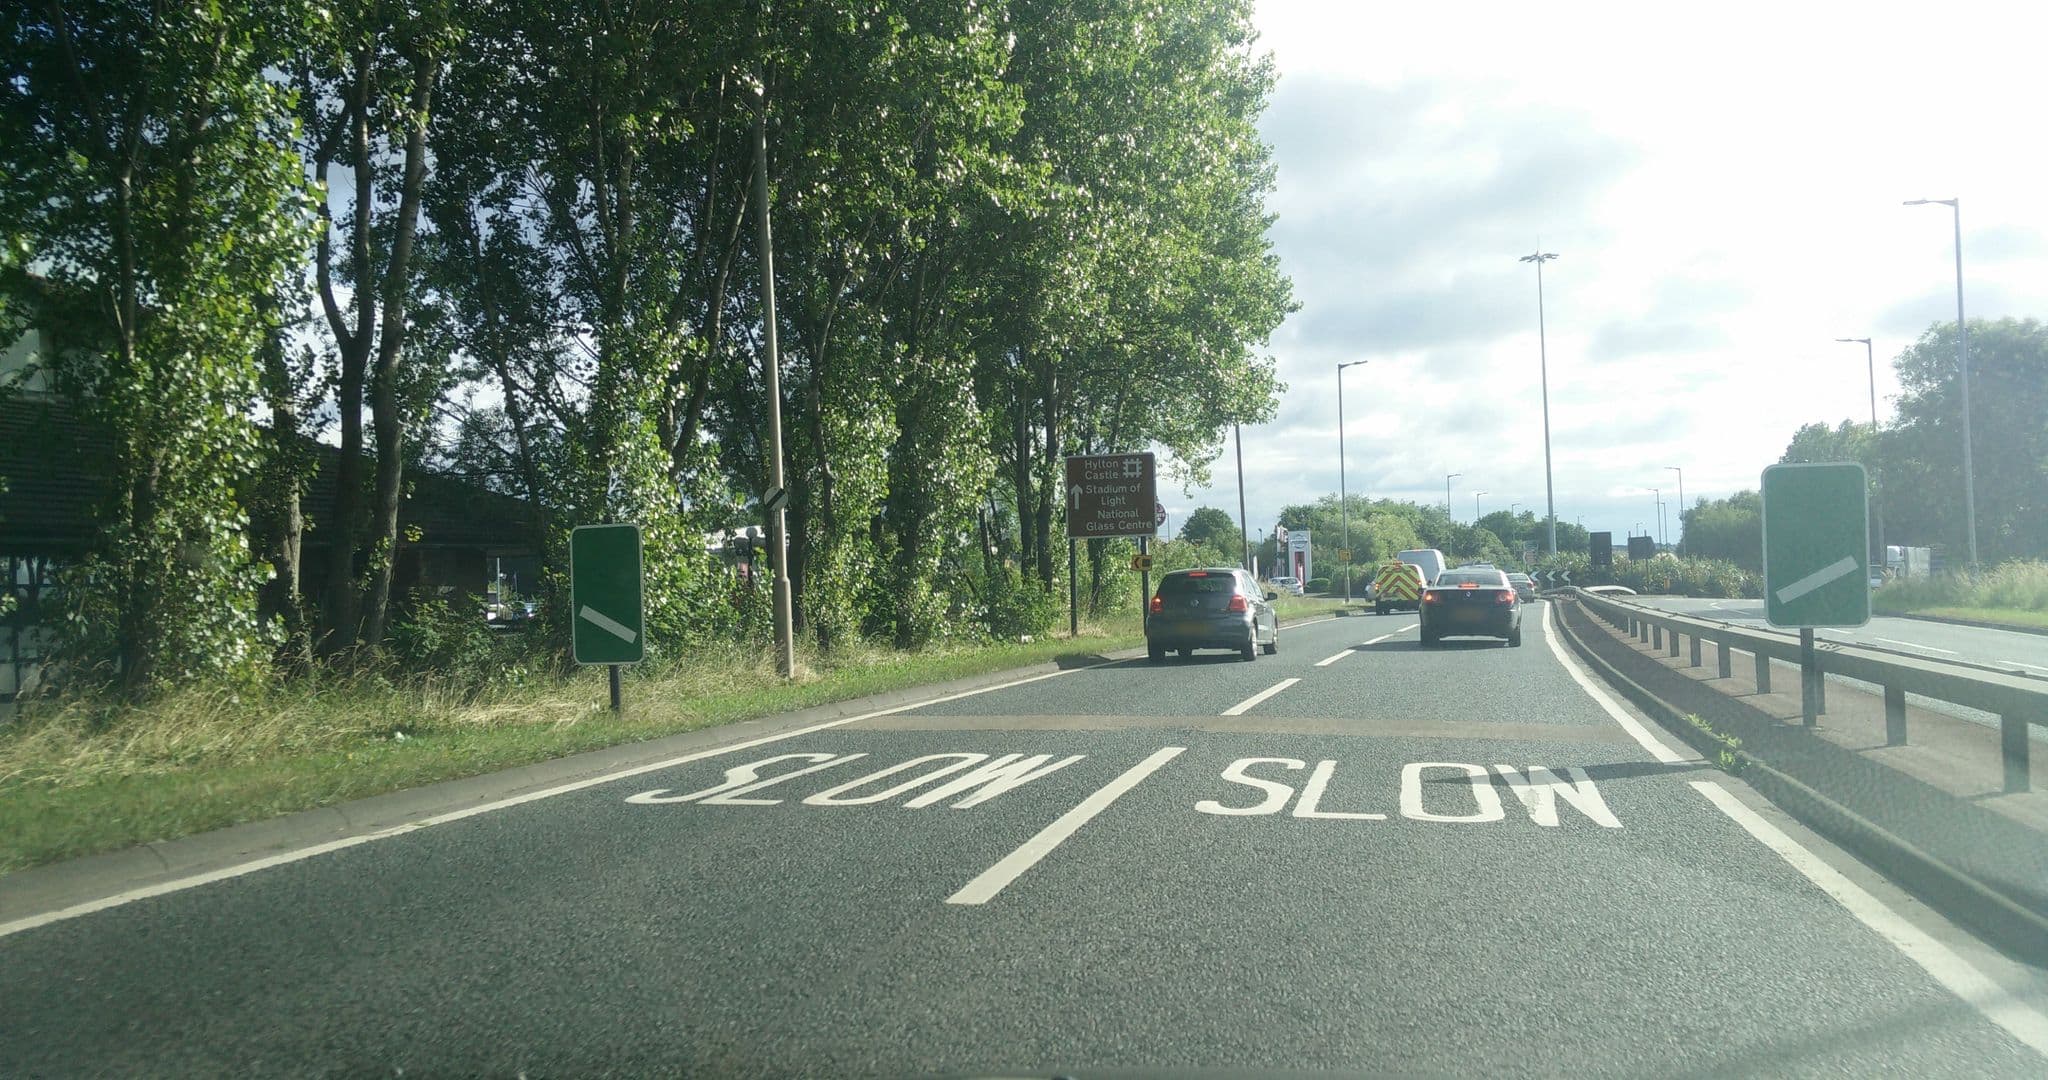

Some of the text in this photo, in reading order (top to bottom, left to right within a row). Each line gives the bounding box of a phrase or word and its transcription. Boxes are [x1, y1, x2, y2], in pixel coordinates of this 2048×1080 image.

[1084, 460, 1119, 471] Hylton
[1084, 470, 1119, 480] Castle
[1086, 483, 1141, 494] Stadium of
[1101, 496, 1126, 507] Light
[1097, 509, 1139, 520] National
[1086, 520, 1153, 532] Glass Centre
[624, 752, 1086, 809] SLOW
[1195, 757, 1624, 829] SLOW
